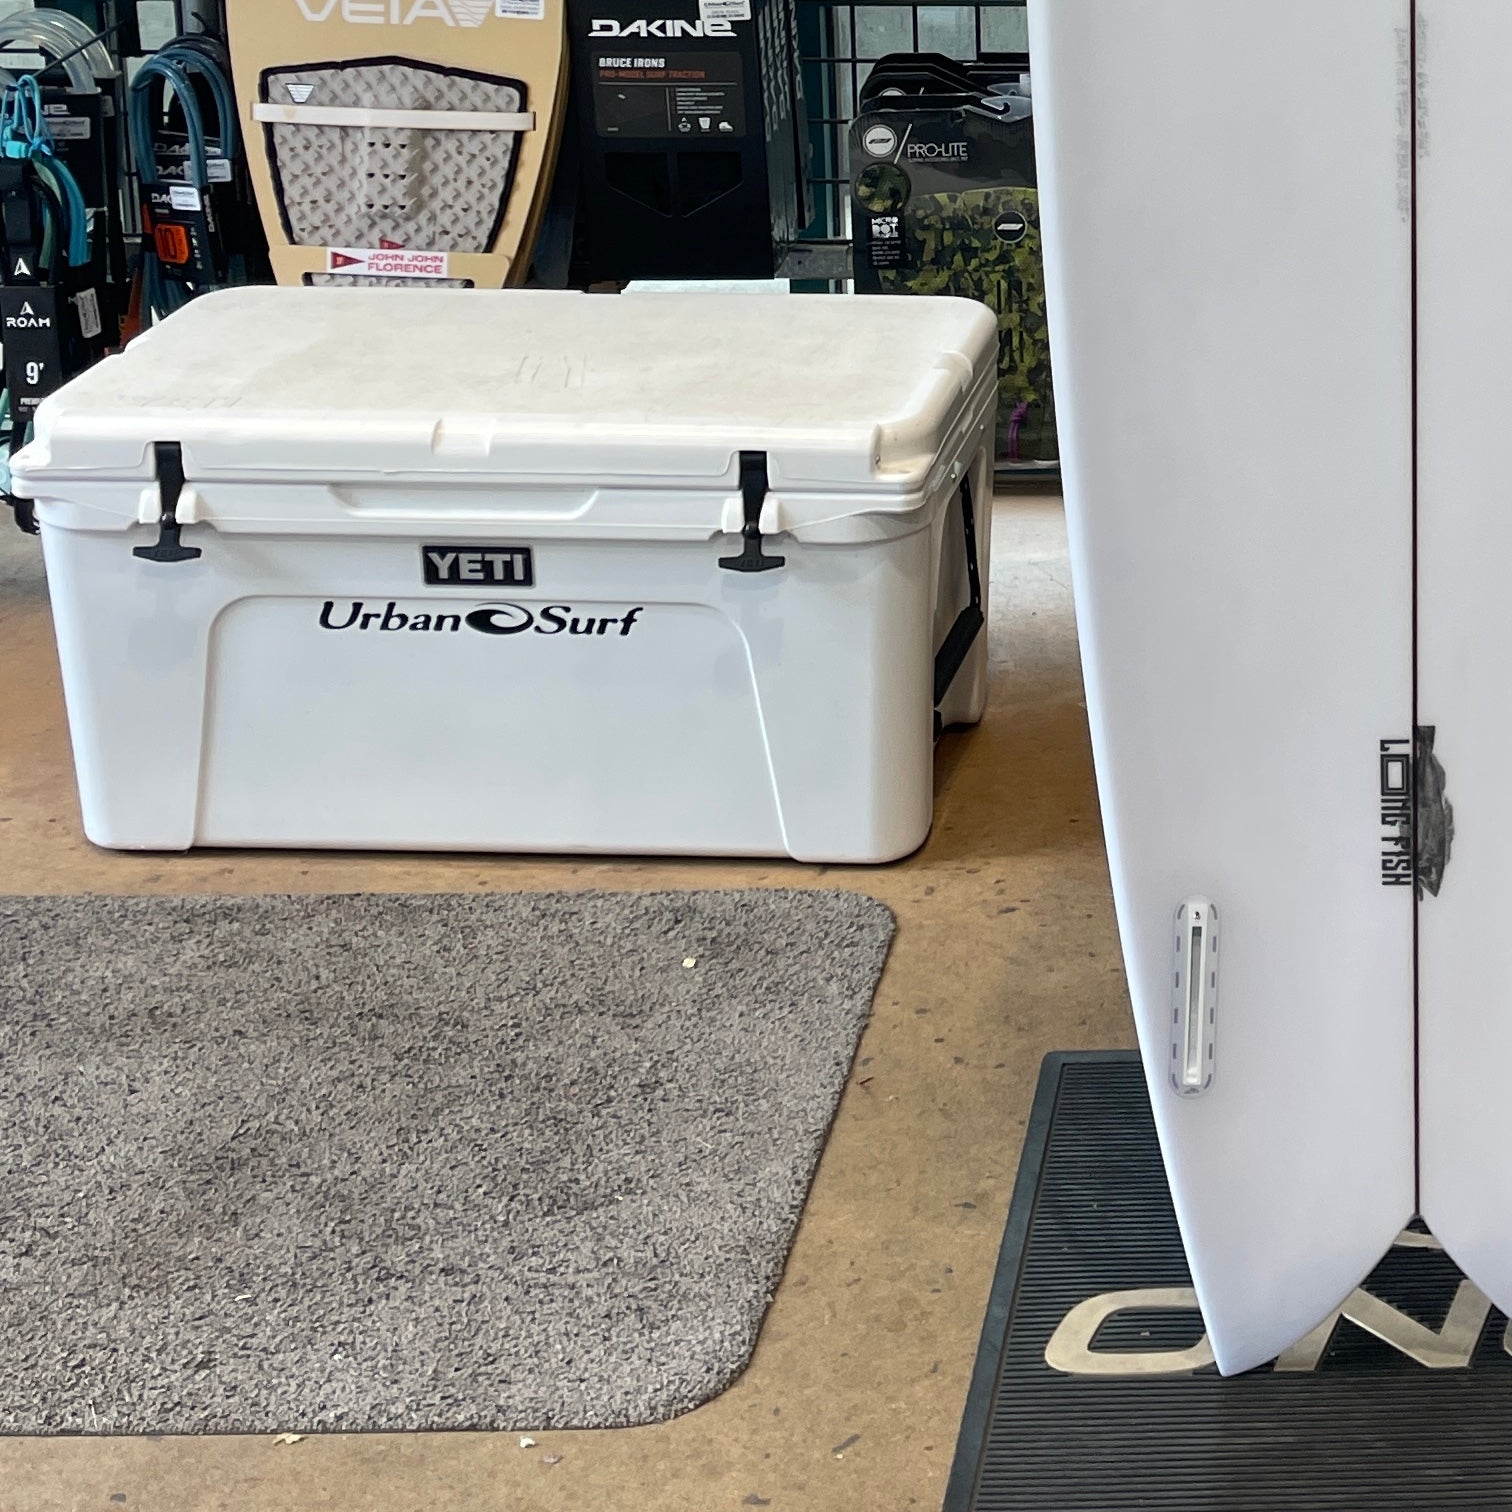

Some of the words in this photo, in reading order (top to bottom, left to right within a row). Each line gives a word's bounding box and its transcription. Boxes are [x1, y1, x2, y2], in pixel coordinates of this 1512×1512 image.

[588, 19, 738, 37] DAKINE
[598, 57, 632, 68] BRUCE
[633, 57, 666, 68] IRONS
[907, 142, 968, 158] PRO-LITE
[367, 253, 404, 262] JOHN
[407, 254, 444, 263] JOHN
[367, 262, 443, 274] FLORENCE
[6, 317, 50, 328] ROAM
[26, 362, 45, 385] 9'
[426, 552, 526, 582] YETI
[319, 601, 461, 633] Urban
[534, 605, 644, 637] Surf
